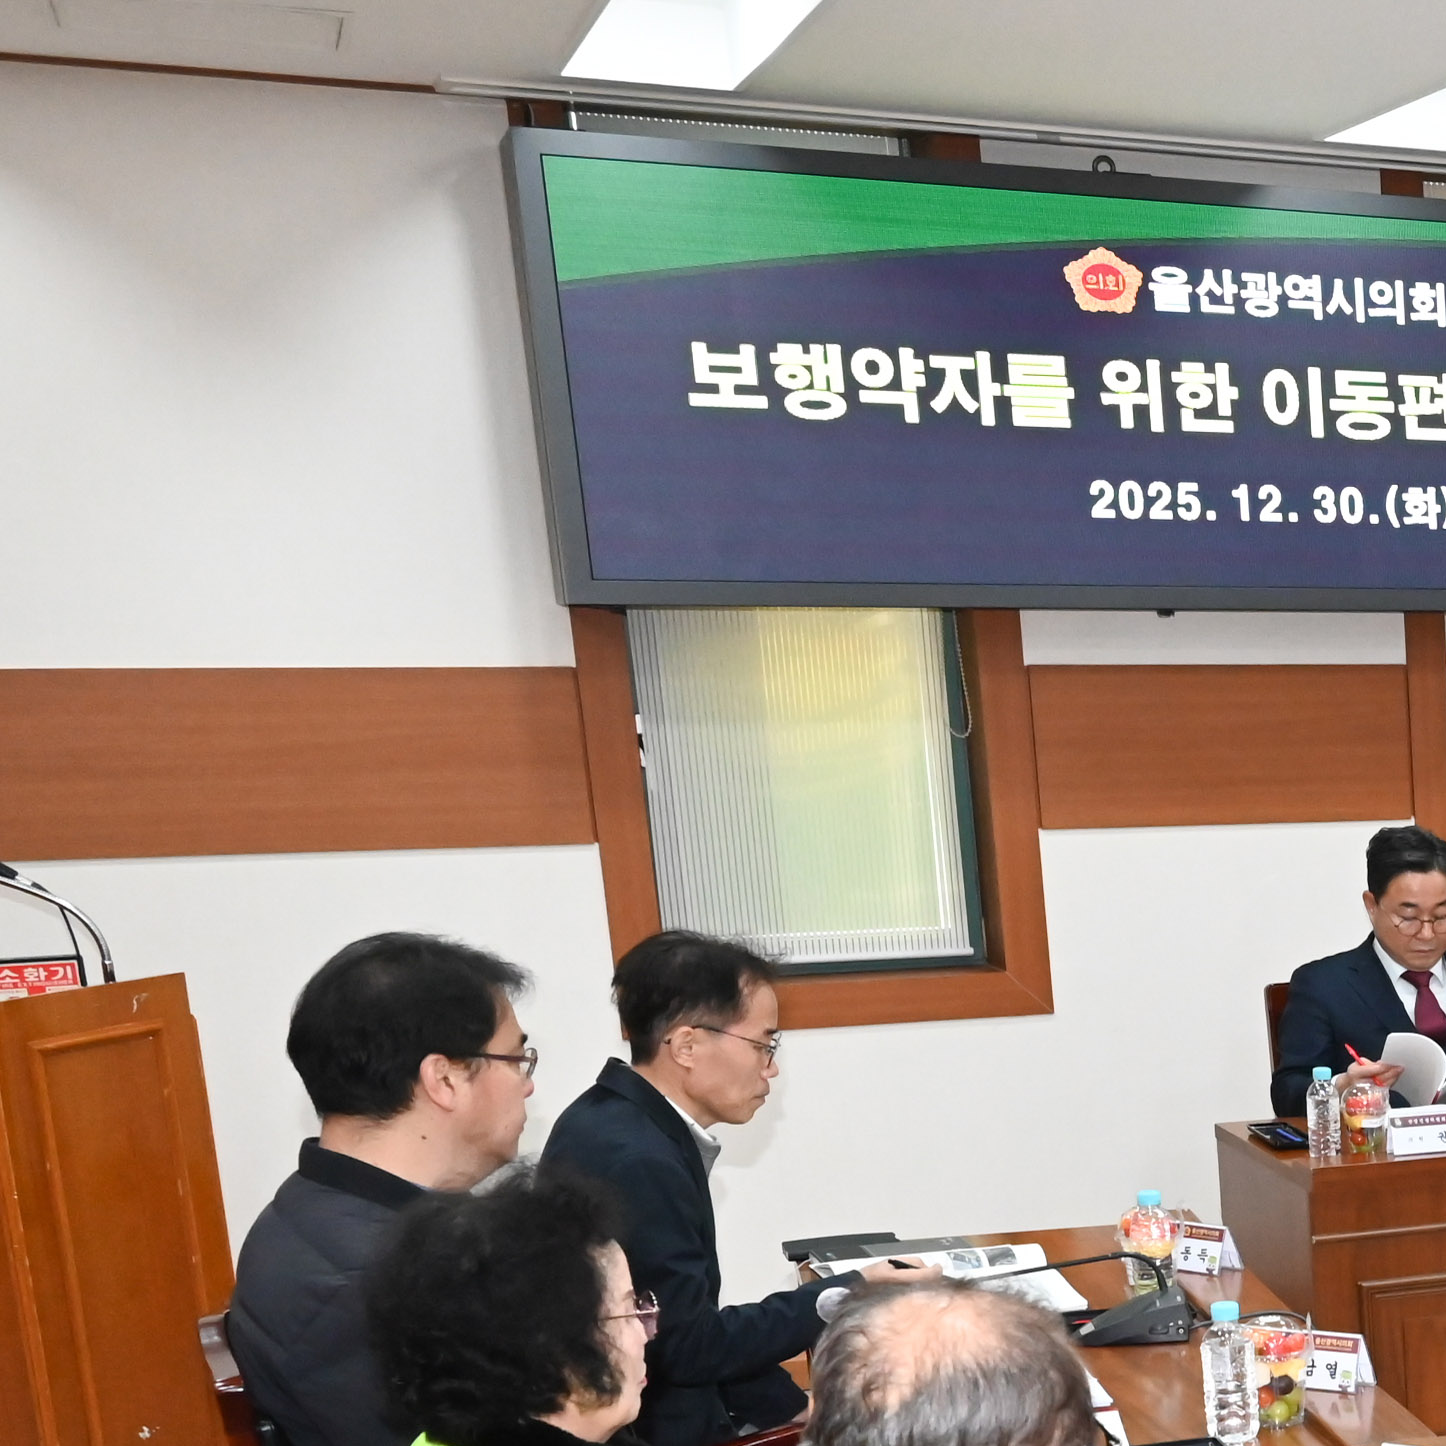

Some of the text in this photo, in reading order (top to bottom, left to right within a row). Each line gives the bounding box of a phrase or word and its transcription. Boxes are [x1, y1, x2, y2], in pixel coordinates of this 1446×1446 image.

[1085, 272, 1124, 290] 의회
[1148, 266, 1446, 328] 울산광역시의회
[688, 341, 1075, 429] 보행약자를
[1100, 358, 1240, 433] 위한
[1089, 479, 1217, 522] 2025.
[1231, 483, 1299, 523] 12.
[0, 965, 73, 983] 소화기
